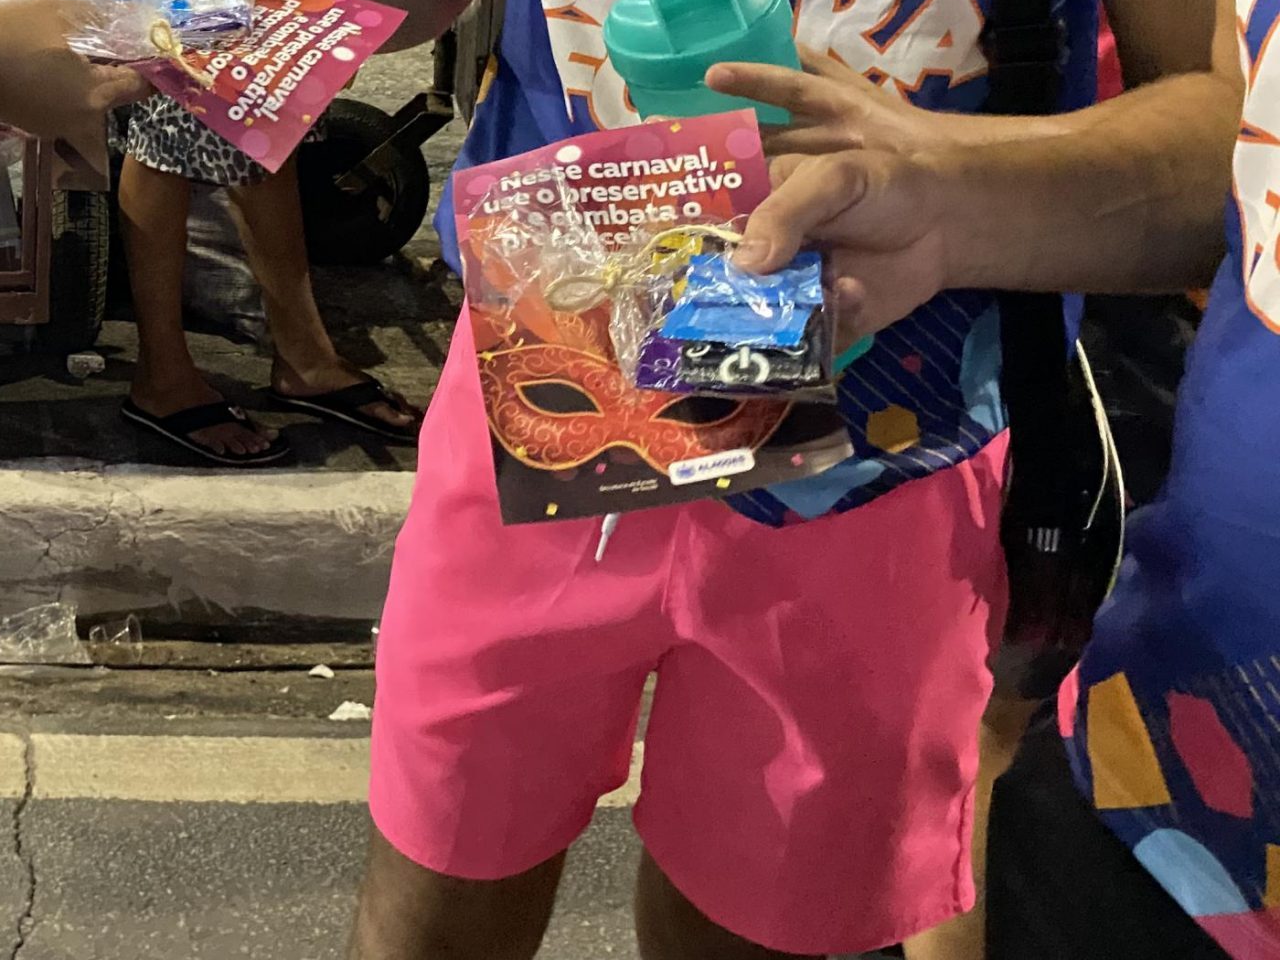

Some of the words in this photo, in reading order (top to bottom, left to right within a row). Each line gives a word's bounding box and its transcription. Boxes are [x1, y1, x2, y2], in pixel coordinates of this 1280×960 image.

[294, 15, 310, 25] e
[309, 23, 324, 34] o
[318, 7, 346, 29] use
[241, 21, 301, 67] combata
[316, 21, 362, 51] Nesse
[228, 29, 317, 121] preservativo
[230, 65, 248, 81] o
[254, 49, 323, 122] carnaval,
[500, 163, 583, 192] Nesse
[588, 145, 718, 179] carnaval,
[536, 188, 555, 204] o
[563, 171, 743, 210] preservativo
[550, 203, 678, 227] combata
[682, 201, 702, 218] o
